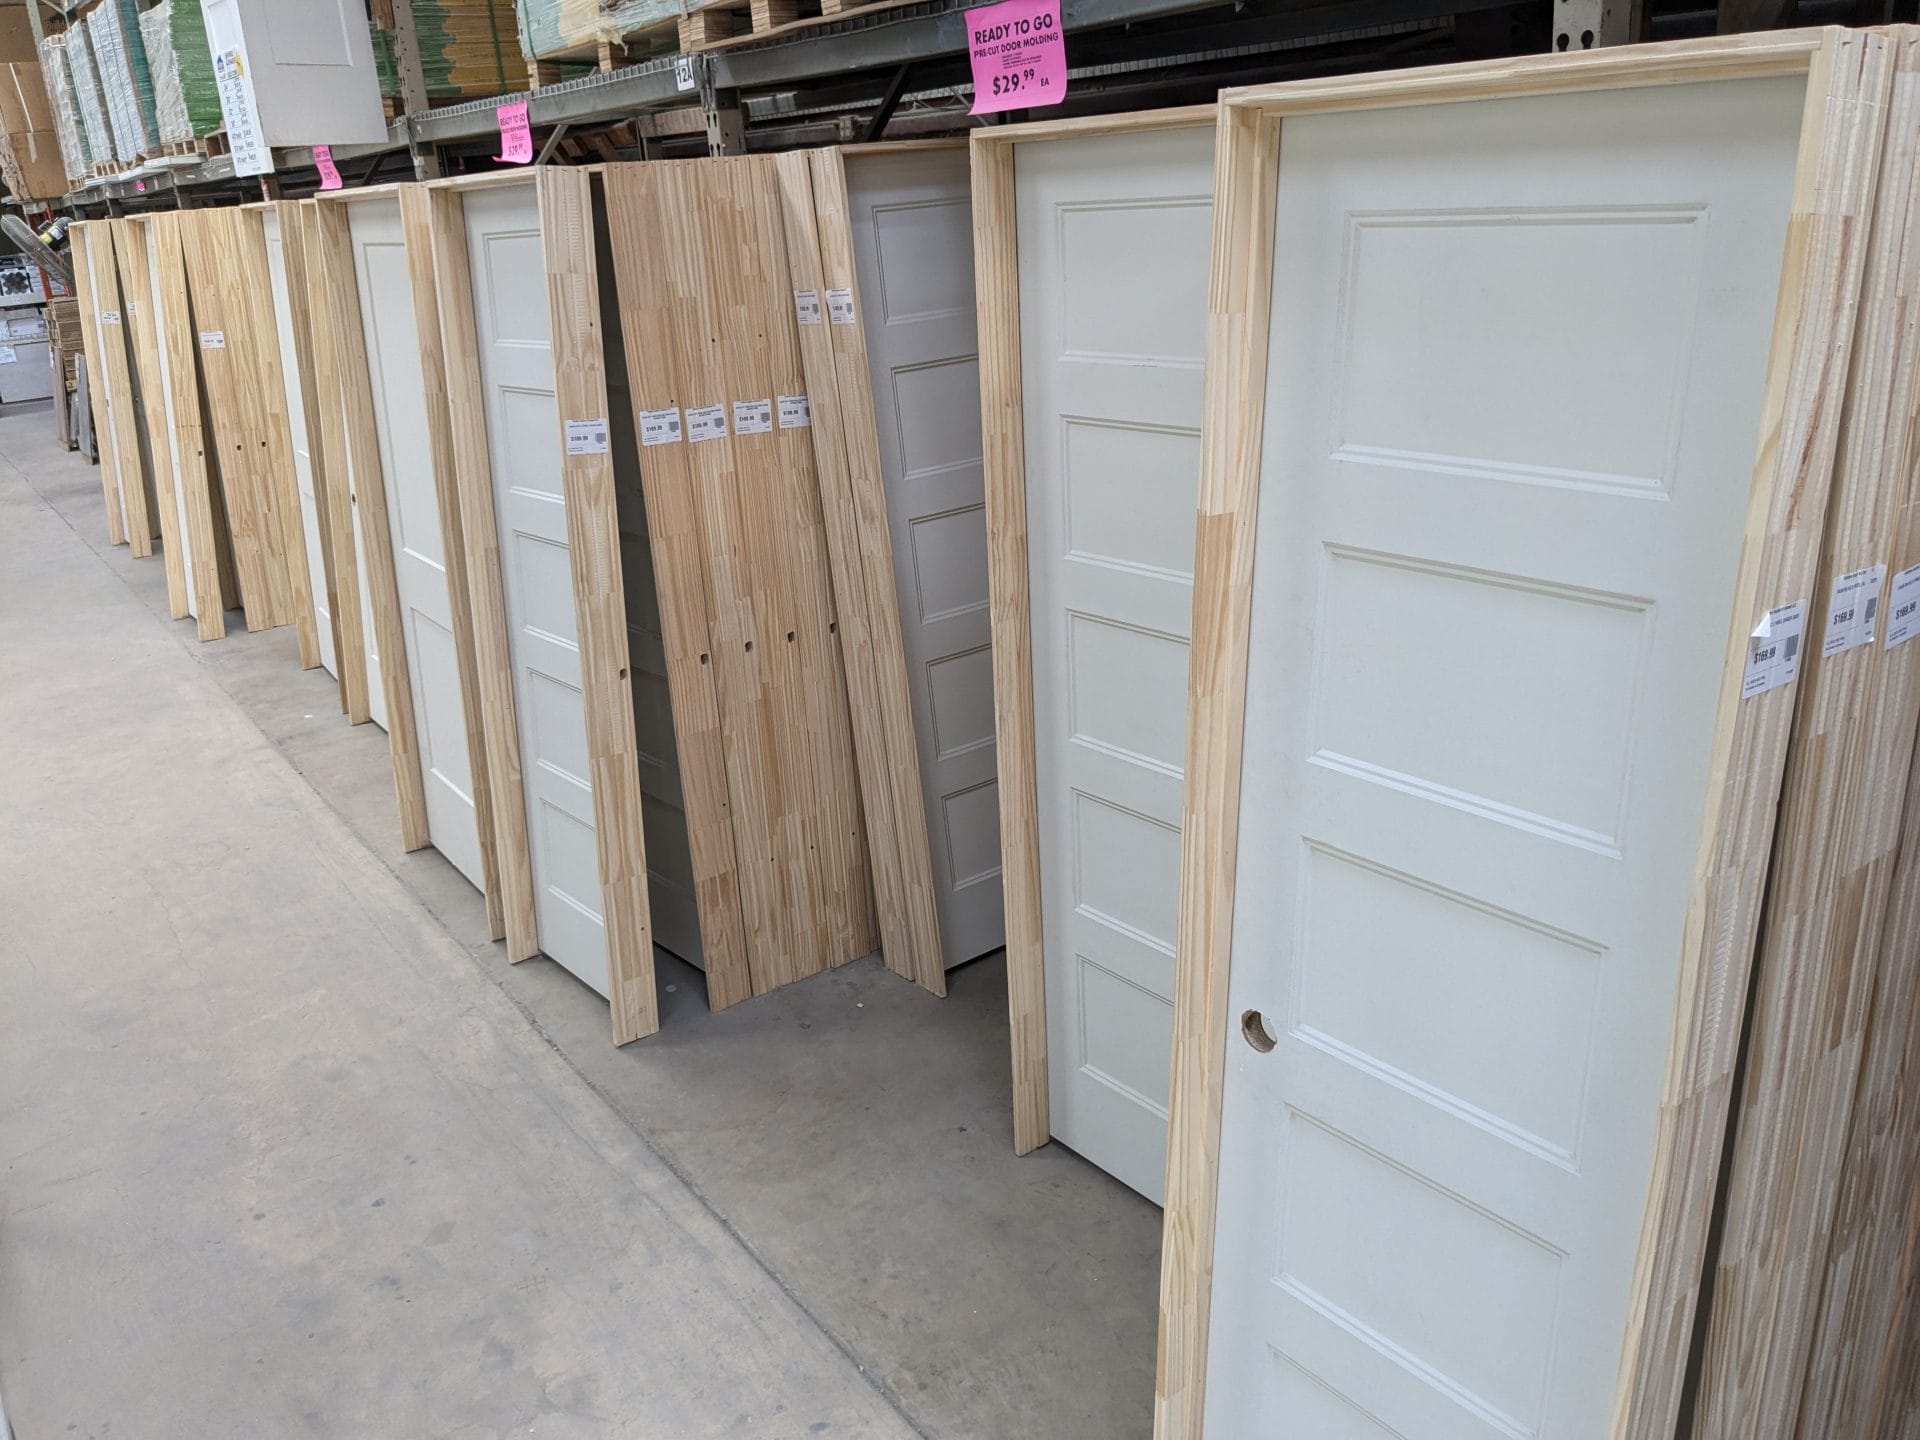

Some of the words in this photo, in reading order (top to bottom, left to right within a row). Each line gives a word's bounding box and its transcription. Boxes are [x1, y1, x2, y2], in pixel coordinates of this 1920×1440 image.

[974, 23, 1011, 45] READY
[1014, 19, 1030, 36] TO
[1033, 13, 1053, 31] GO
[973, 45, 1000, 59] PRE-CUT
[1001, 40, 1022, 53] DOOR
[1023, 32, 1059, 48] MOLDING
[675, 67, 693, 84] 12A
[1040, 77, 1050, 87] EA
